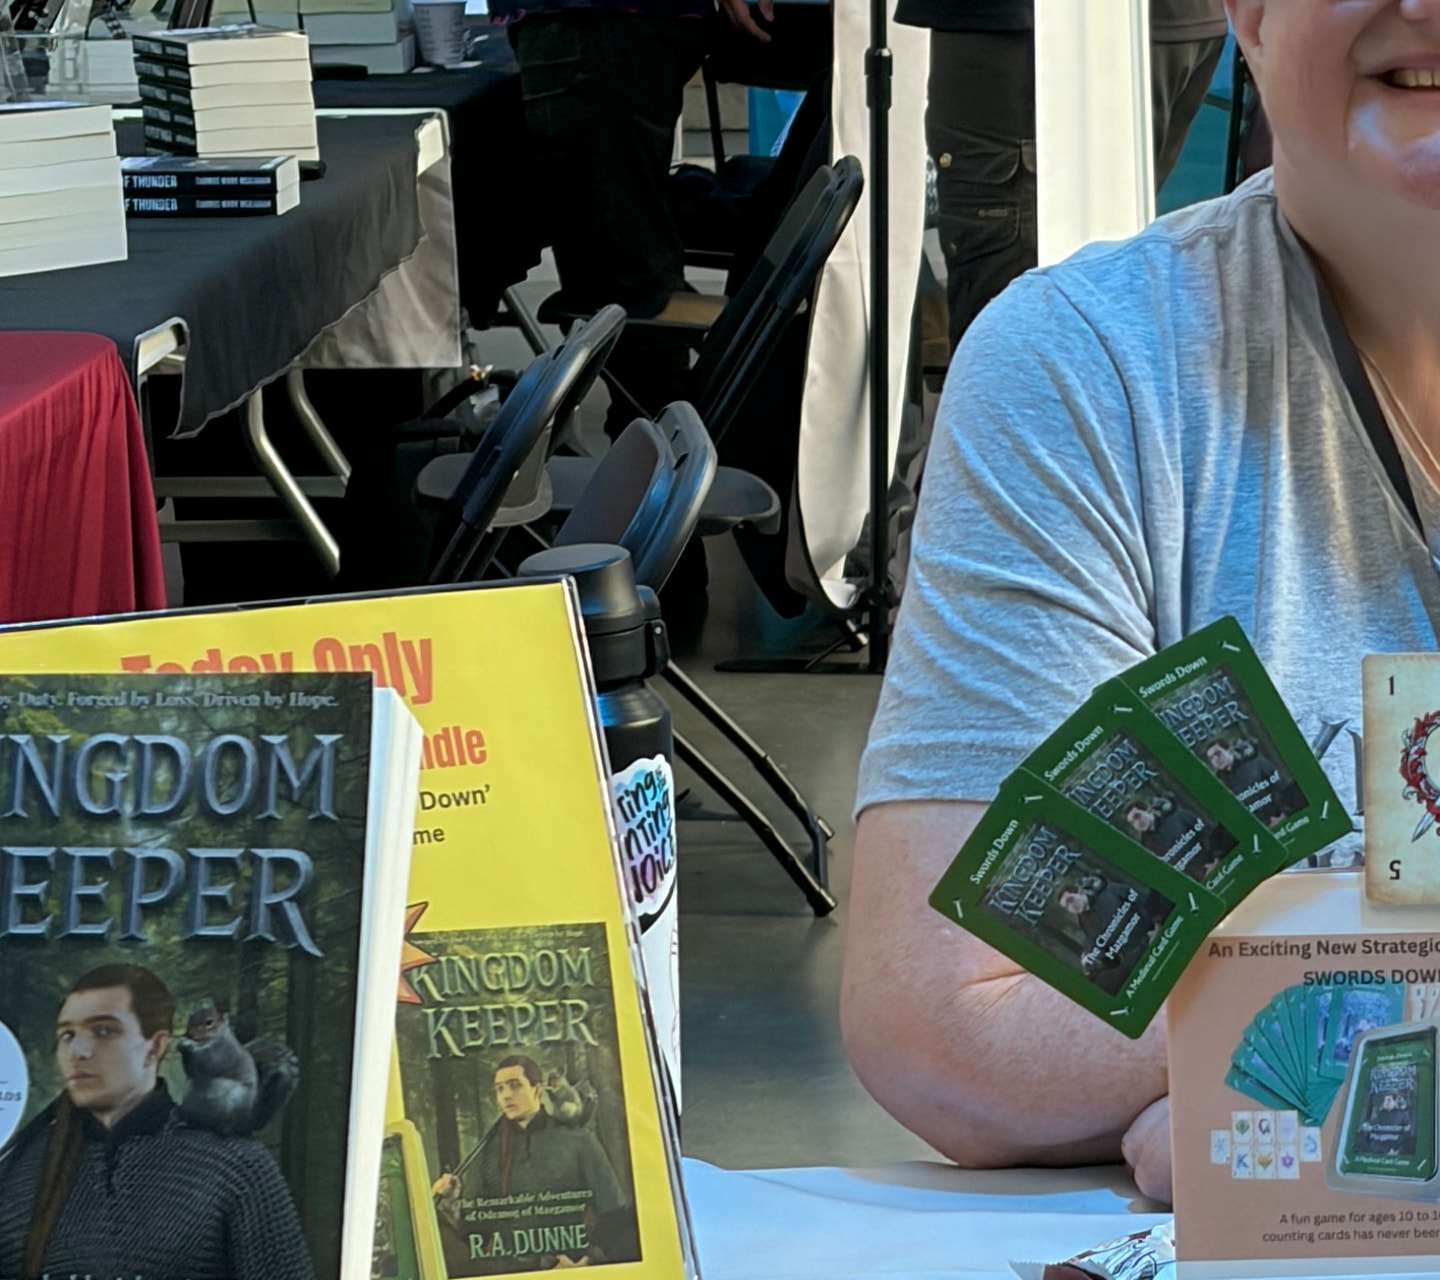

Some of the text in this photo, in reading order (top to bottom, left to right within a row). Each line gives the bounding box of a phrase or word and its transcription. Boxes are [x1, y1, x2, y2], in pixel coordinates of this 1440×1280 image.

[314, 632, 432, 705] Only
[1139, 656, 1207, 698] Swords Down
[1389, 676, 1395, 695] 1
[0, 733, 344, 819] NGDOM
[970, 819, 1019, 884] Swords Down
[988, 824, 1057, 917] KINGDOM
[0, 846, 325, 957] EEPER
[1015, 844, 1082, 927] KEEPER
[411, 947, 594, 1005] KINGDOM
[1208, 943, 1232, 957] An
[1239, 940, 1311, 959] Exciting
[1317, 941, 1356, 955] New
[1303, 970, 1385, 986] SWORDS
[422, 999, 598, 1060] KEEPER
[470, 1225, 589, 1259] R.A. DUNNE
[1262, 1230, 1315, 1243] counting
[1318, 1229, 1350, 1241] cards
[1354, 1229, 1373, 1240] has
[1377, 1229, 1410, 1239] never
[1280, 1214, 1287, 1224] A
[1291, 1213, 1310, 1224] fun
[1314, 1214, 1345, 1226] game
[1350, 1211, 1366, 1223] for
[1369, 1212, 1395, 1224] ages
[1399, 1211, 1413, 1221] 10
[1417, 1211, 1429, 1221] to
